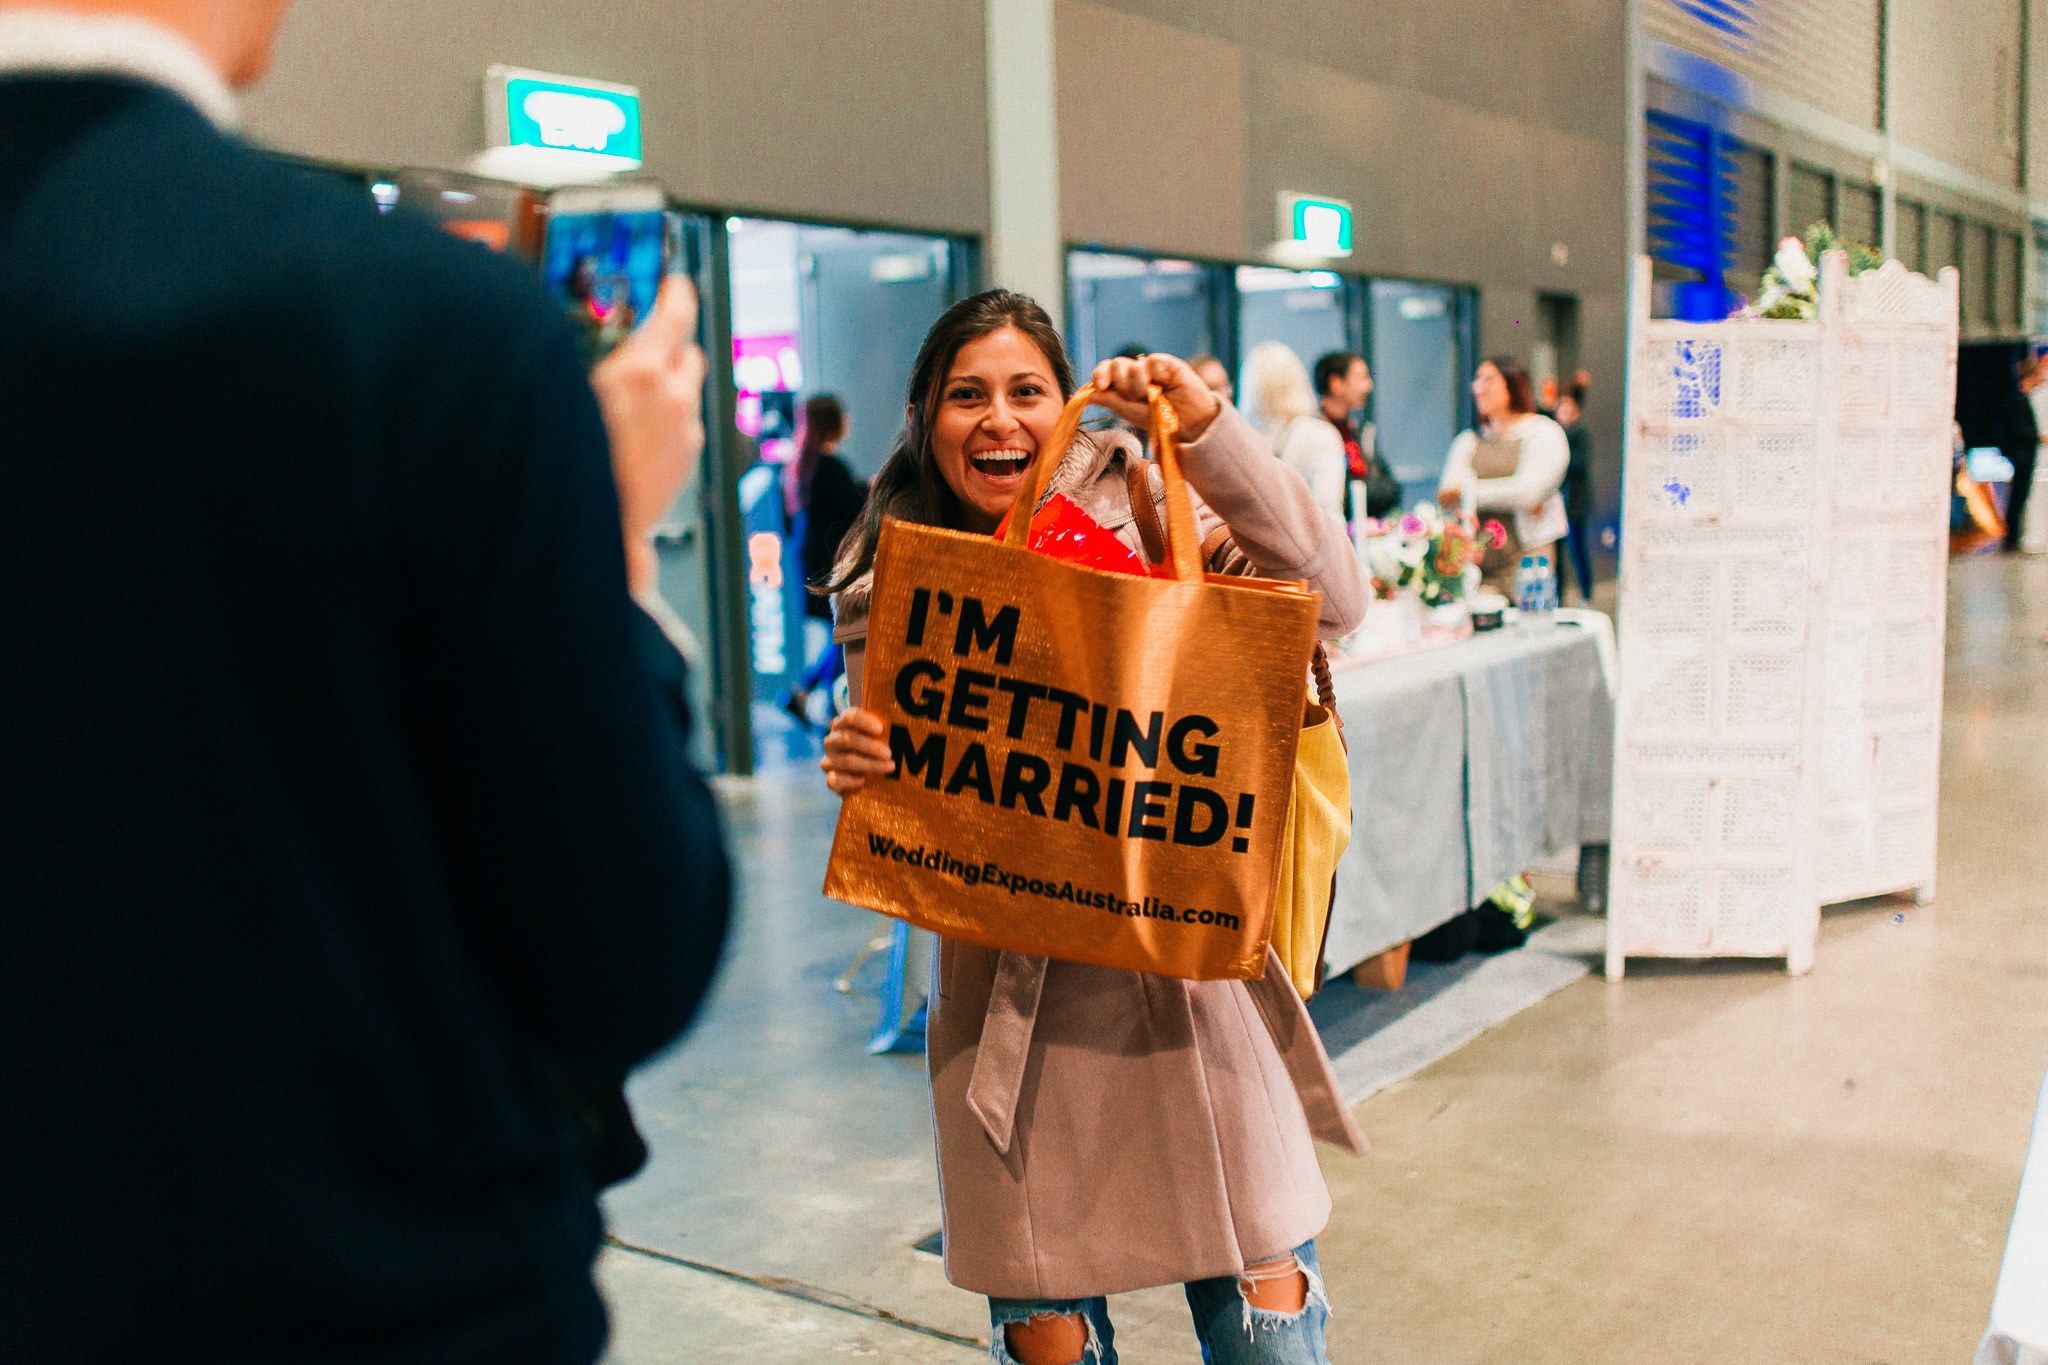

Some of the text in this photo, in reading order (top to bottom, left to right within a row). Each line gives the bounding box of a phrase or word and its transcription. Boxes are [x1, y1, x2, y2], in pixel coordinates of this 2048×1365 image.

[906, 589, 1021, 666] I'M
[895, 660, 1220, 778] GETTING
[885, 724, 1255, 854] MARRIED!
[868, 834, 1240, 931] WeddingExposAustralia.com
